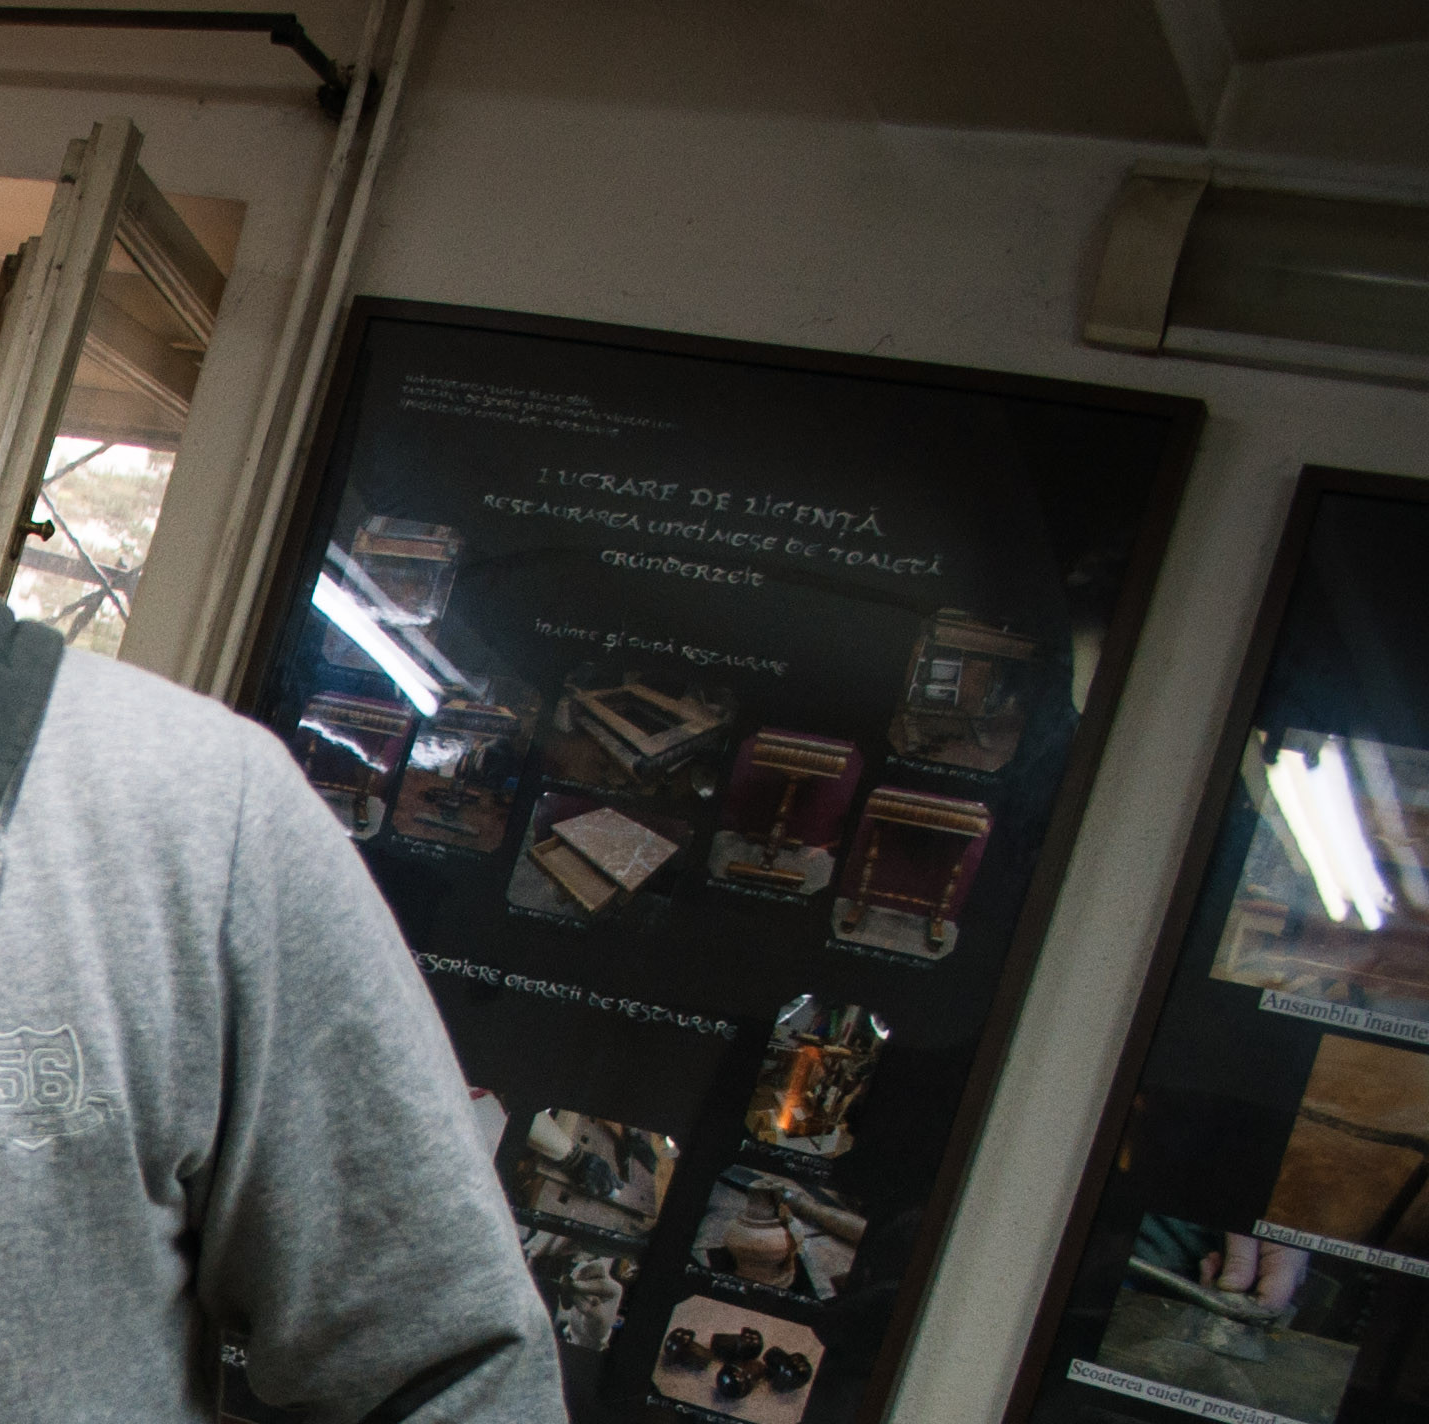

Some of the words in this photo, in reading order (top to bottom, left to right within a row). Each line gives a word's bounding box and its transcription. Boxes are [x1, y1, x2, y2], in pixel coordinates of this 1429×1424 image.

[691, 487, 731, 512] DE
[1262, 991, 1359, 1026] Ansamblu
[1257, 1220, 1313, 1246] Detaliu
[1367, 1248, 1397, 1268] blat
[1071, 1360, 1142, 1393] Scoaterea
[1146, 1381, 1201, 1408] cuielor
